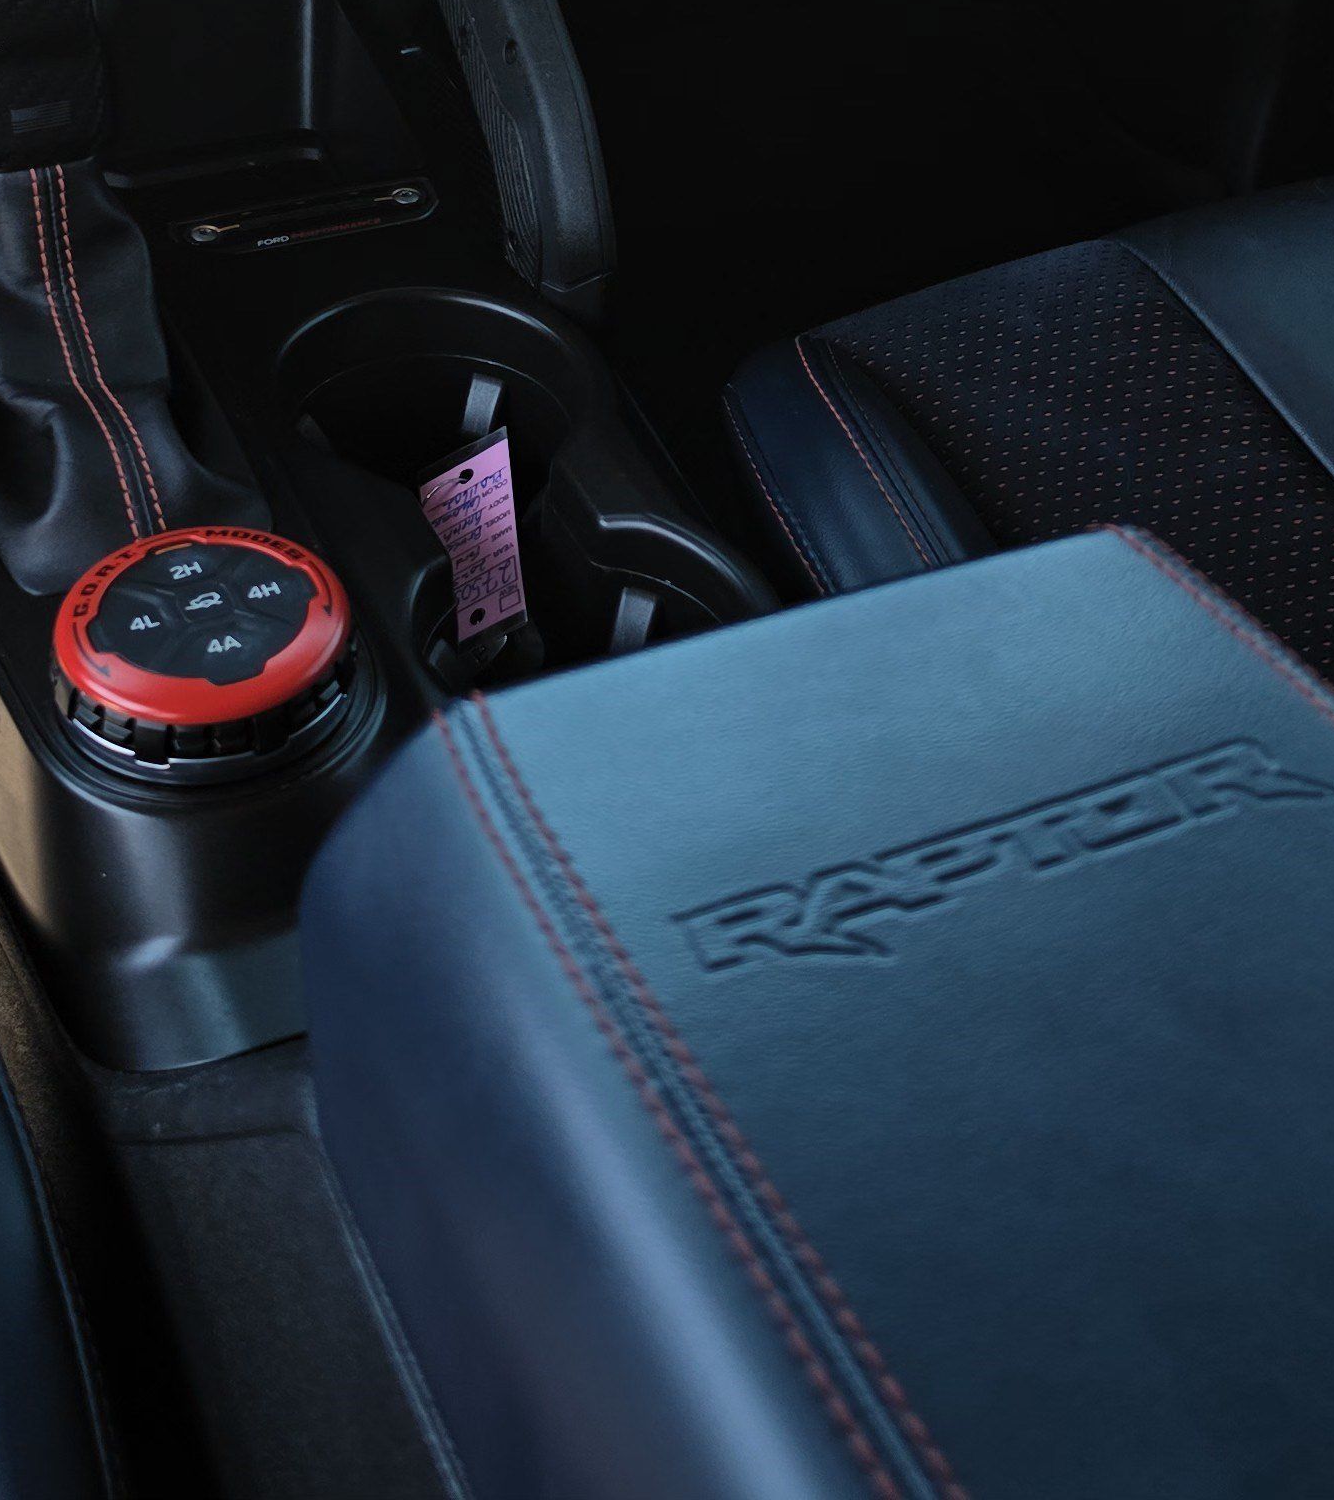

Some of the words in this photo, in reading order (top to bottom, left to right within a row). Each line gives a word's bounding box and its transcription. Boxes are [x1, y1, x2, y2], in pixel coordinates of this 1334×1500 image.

[257, 235, 290, 247] FORD
[482, 478, 508, 497] COLOR
[488, 494, 509, 510] BODY
[484, 510, 511, 528] MODEL
[490, 525, 512, 542] MAKE
[205, 529, 306, 560] MODES
[493, 542, 514, 557] YEAR
[170, 561, 203, 580] 2H
[247, 581, 282, 600] 4H
[129, 615, 161, 633] 4L
[207, 635, 242, 654] 4A
